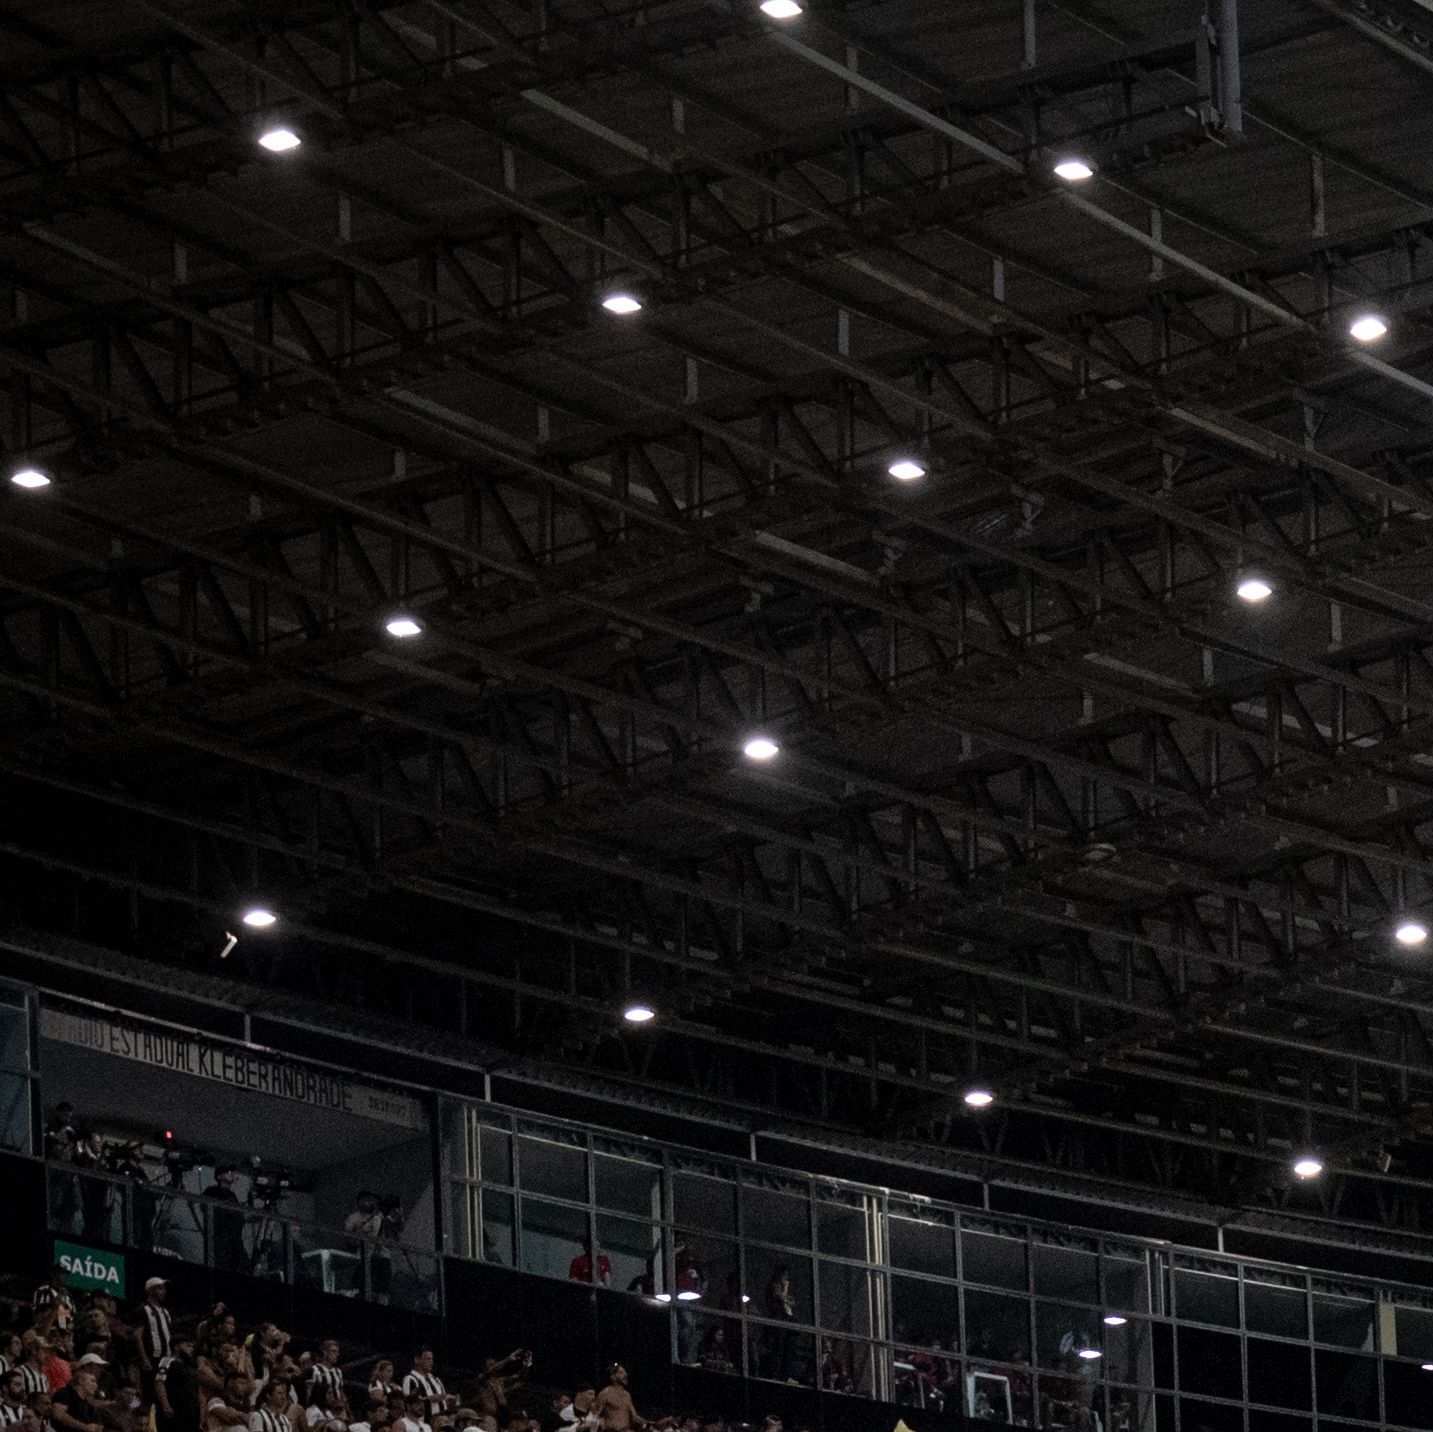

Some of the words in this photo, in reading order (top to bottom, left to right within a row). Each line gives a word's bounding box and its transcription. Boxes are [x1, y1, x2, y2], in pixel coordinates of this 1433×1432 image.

[199, 1047, 269, 1092] KLEBER
[272, 1063, 351, 1109] ANDRADE
[60, 1254, 120, 1284] SAÍDA
